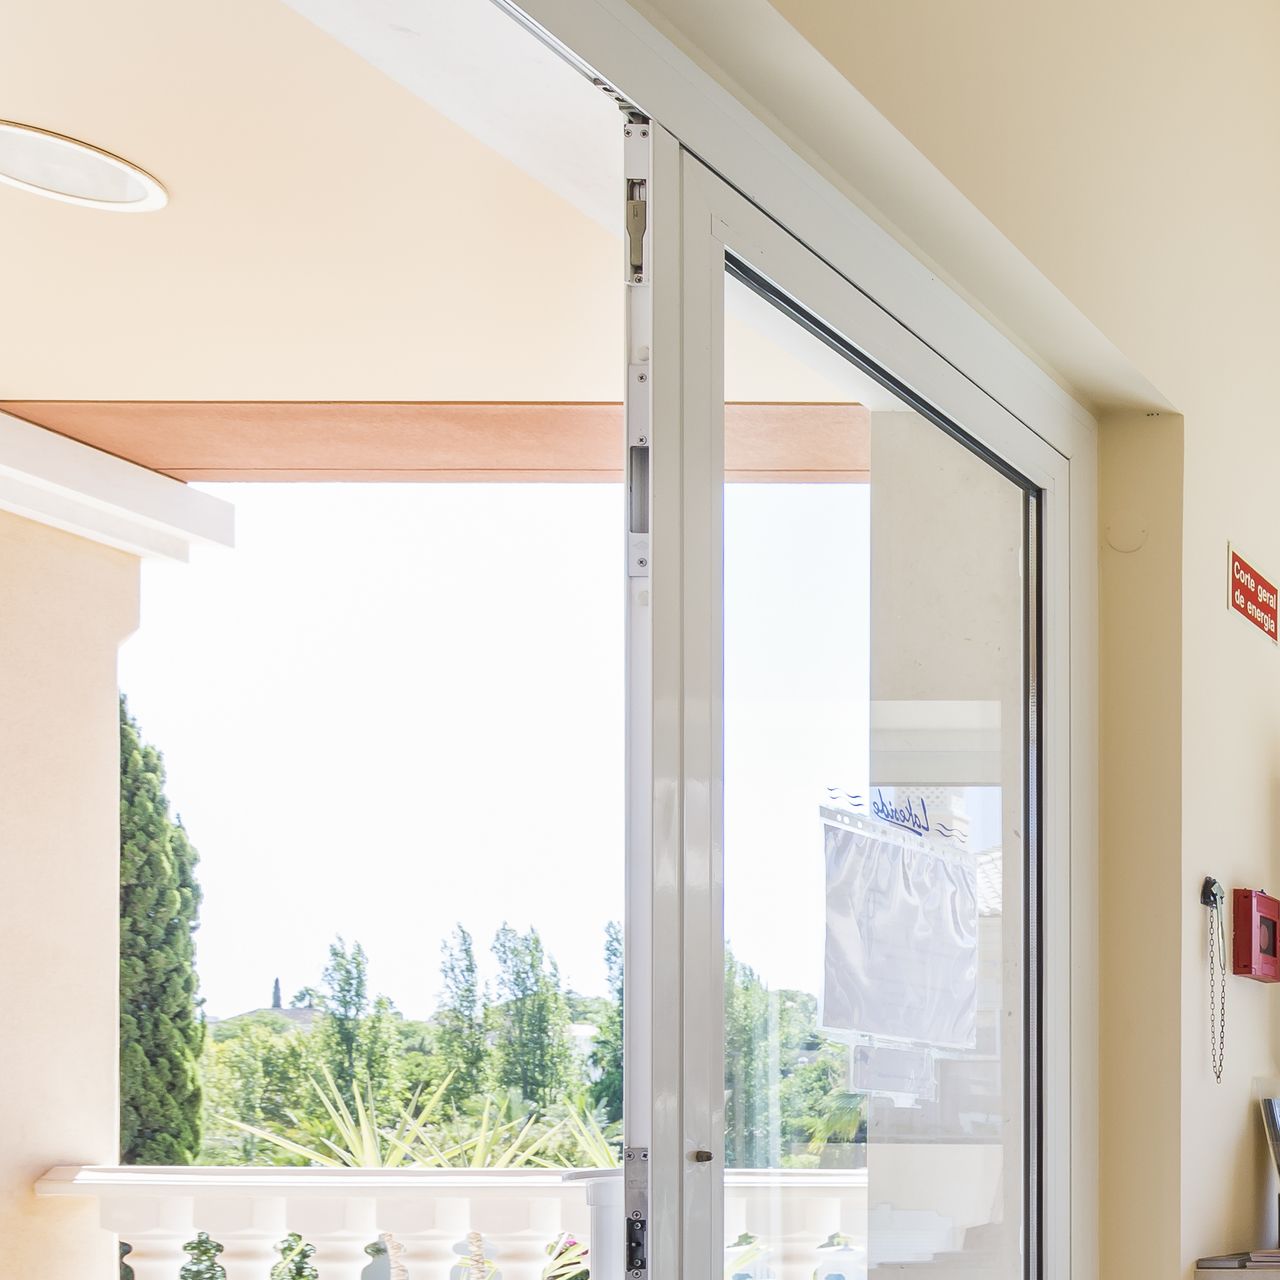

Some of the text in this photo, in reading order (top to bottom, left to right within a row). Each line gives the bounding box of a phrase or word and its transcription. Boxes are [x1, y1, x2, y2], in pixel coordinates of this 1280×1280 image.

[1233, 560, 1276, 610] Corte geral
[1234, 589, 1276, 633] de energia
